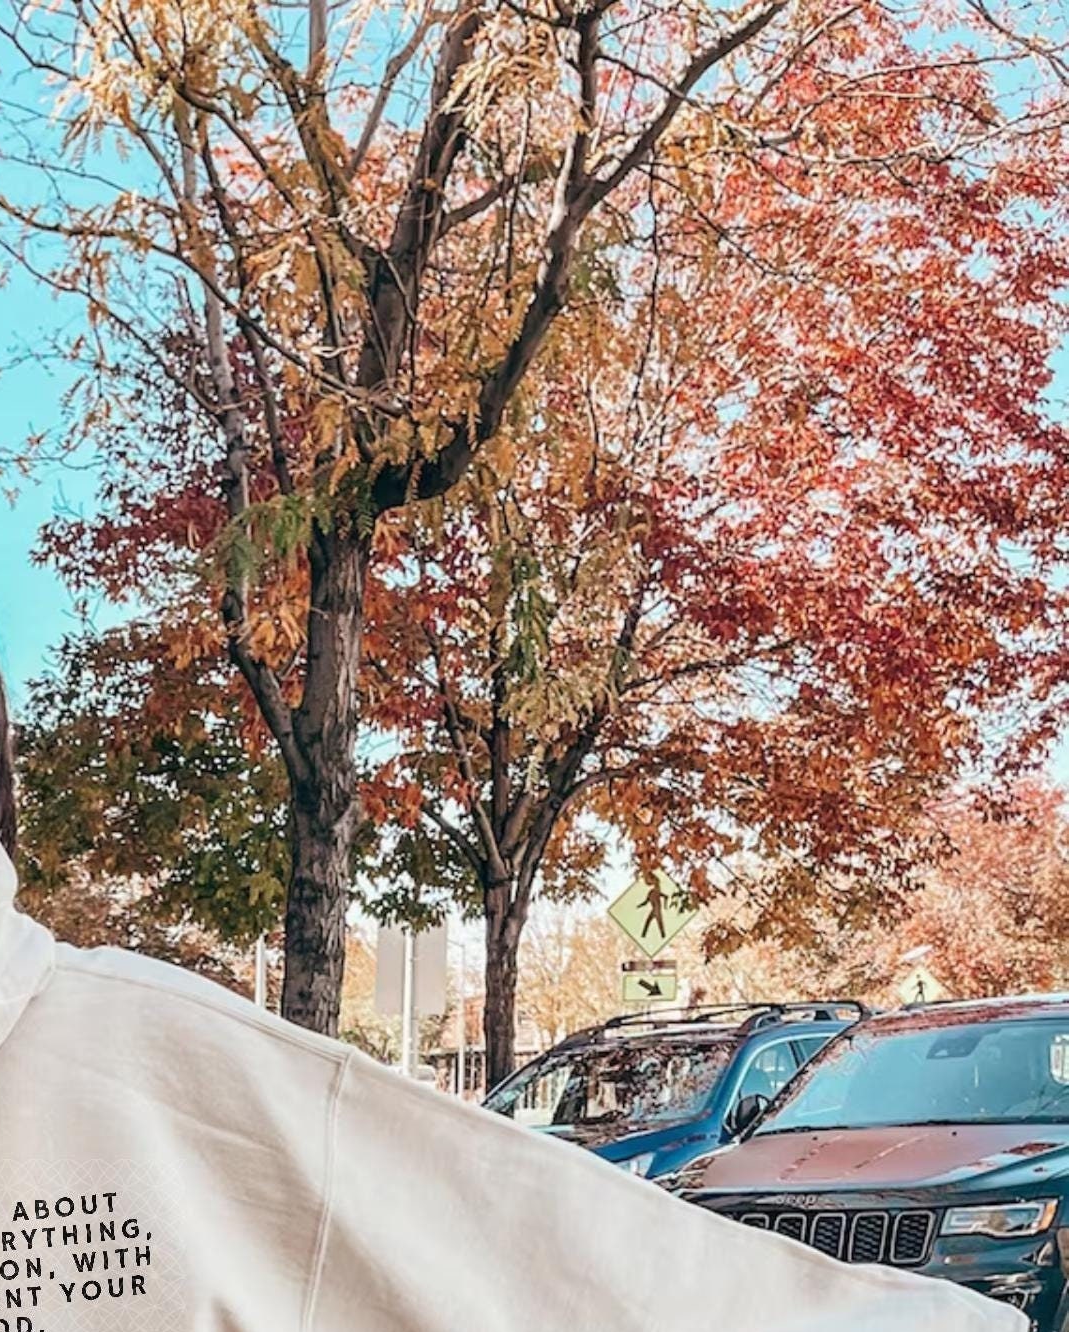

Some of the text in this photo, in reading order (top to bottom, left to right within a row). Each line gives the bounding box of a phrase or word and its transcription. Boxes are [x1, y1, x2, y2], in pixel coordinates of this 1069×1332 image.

[13, 1192, 116, 1221] ABOUT
[775, 1193, 819, 1206] Jeep
[72, 1246, 150, 1272] WITH
[59, 1275, 146, 1302] YOUR
